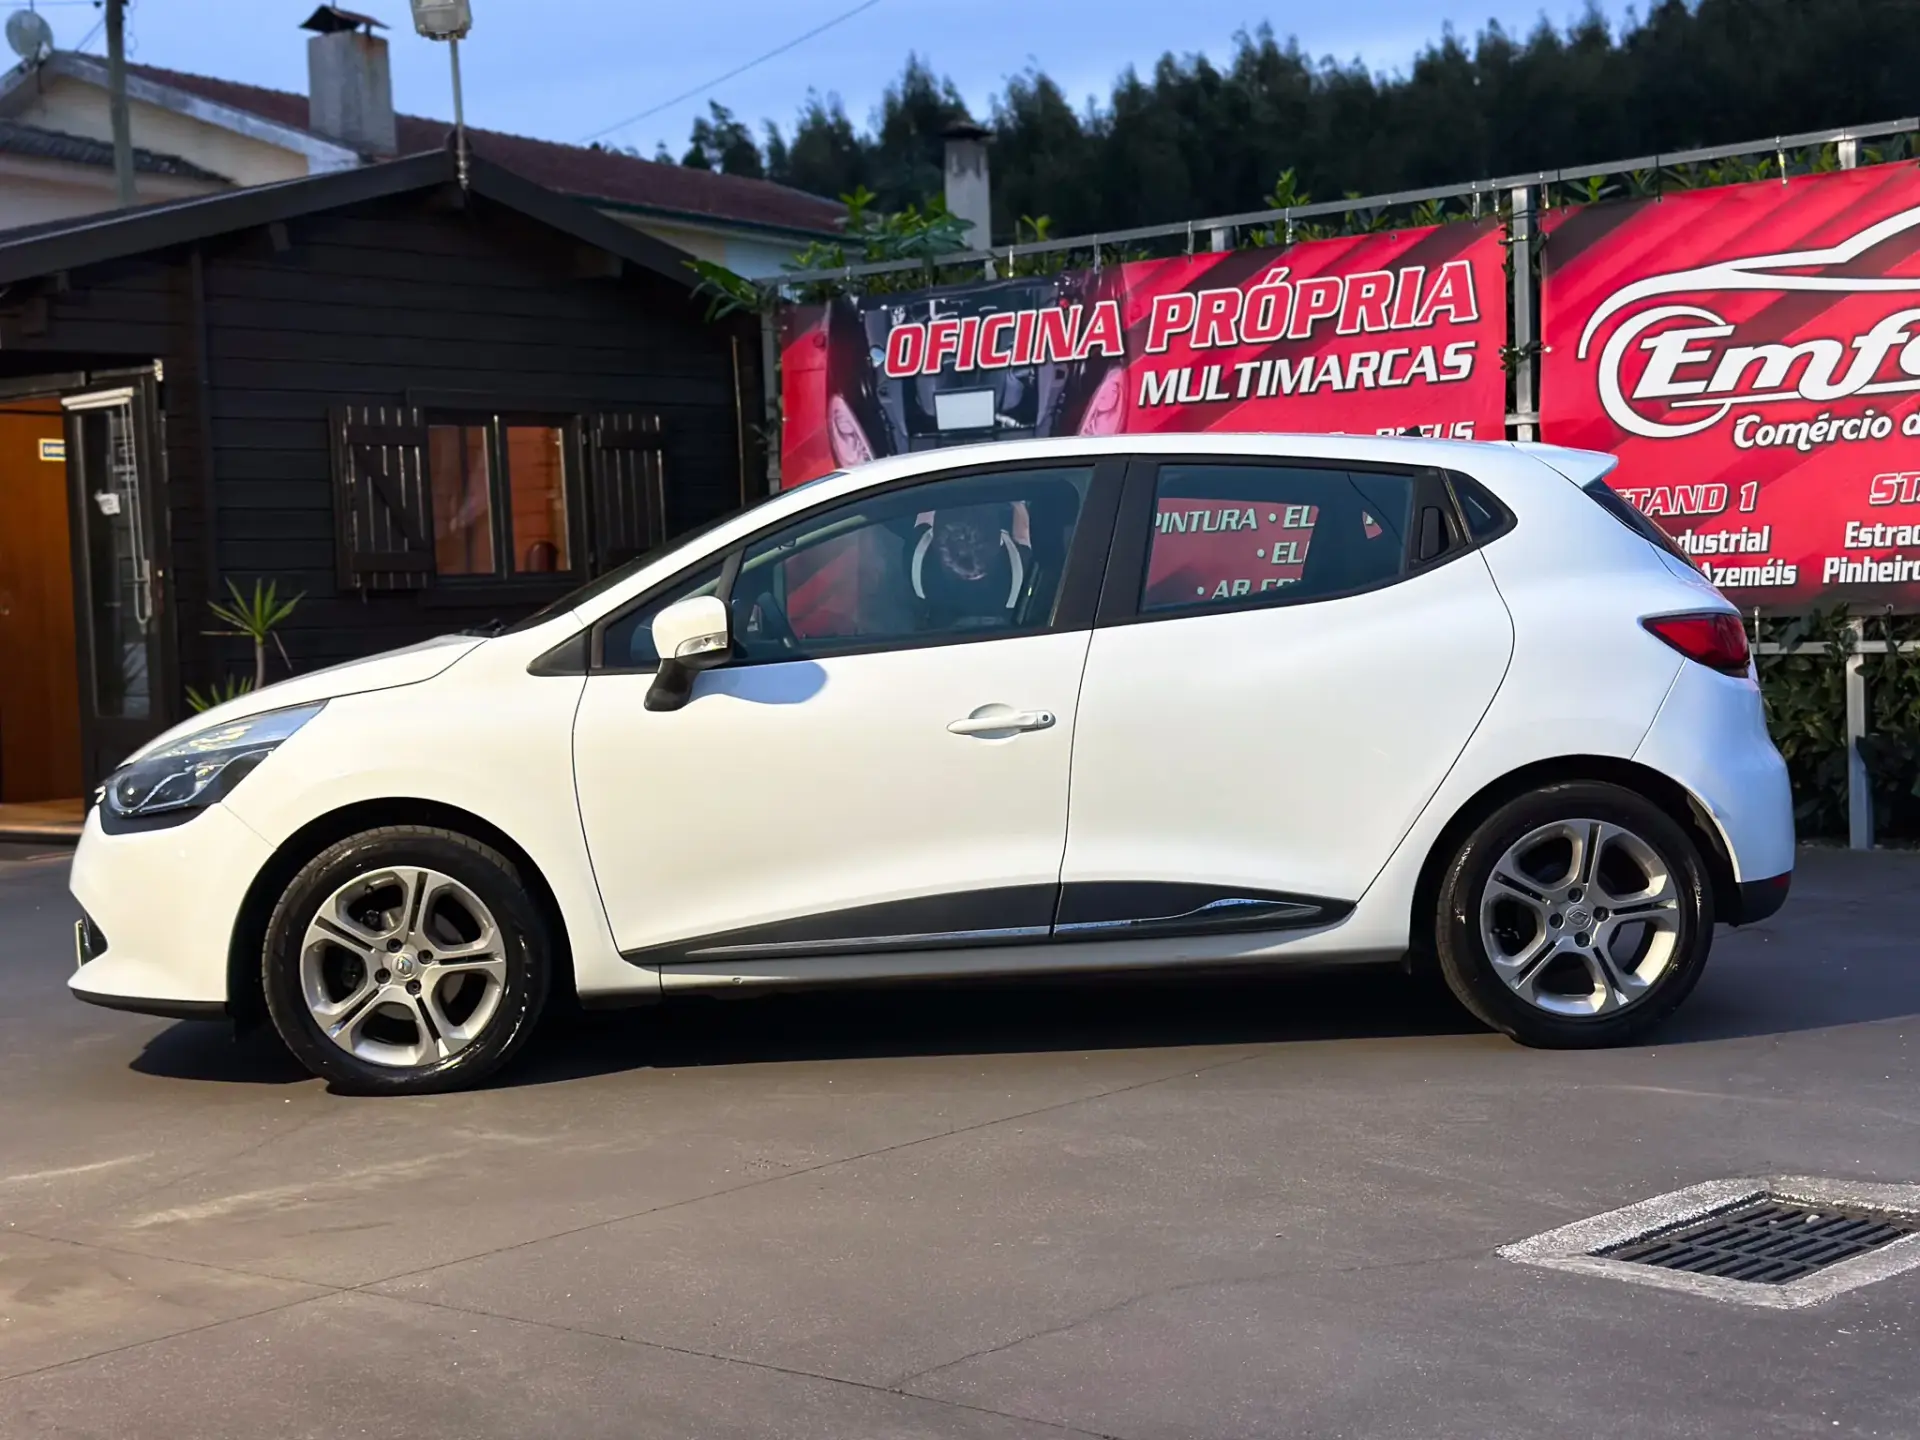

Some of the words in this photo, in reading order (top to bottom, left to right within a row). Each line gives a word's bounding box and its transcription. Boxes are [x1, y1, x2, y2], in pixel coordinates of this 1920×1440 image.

[885, 300, 1123, 378] OFICINA
[1145, 259, 1479, 354] PRÓPRIA
[1138, 341, 1478, 408] MULTIMARCAS
[1376, 421, 1475, 440] EUS
[1733, 410, 1893, 450] Comércio
[1739, 481, 1758, 512] 1
[1869, 471, 1920, 504] ST
[1271, 541, 1310, 564] EL
[1672, 525, 1770, 554] dustrial
